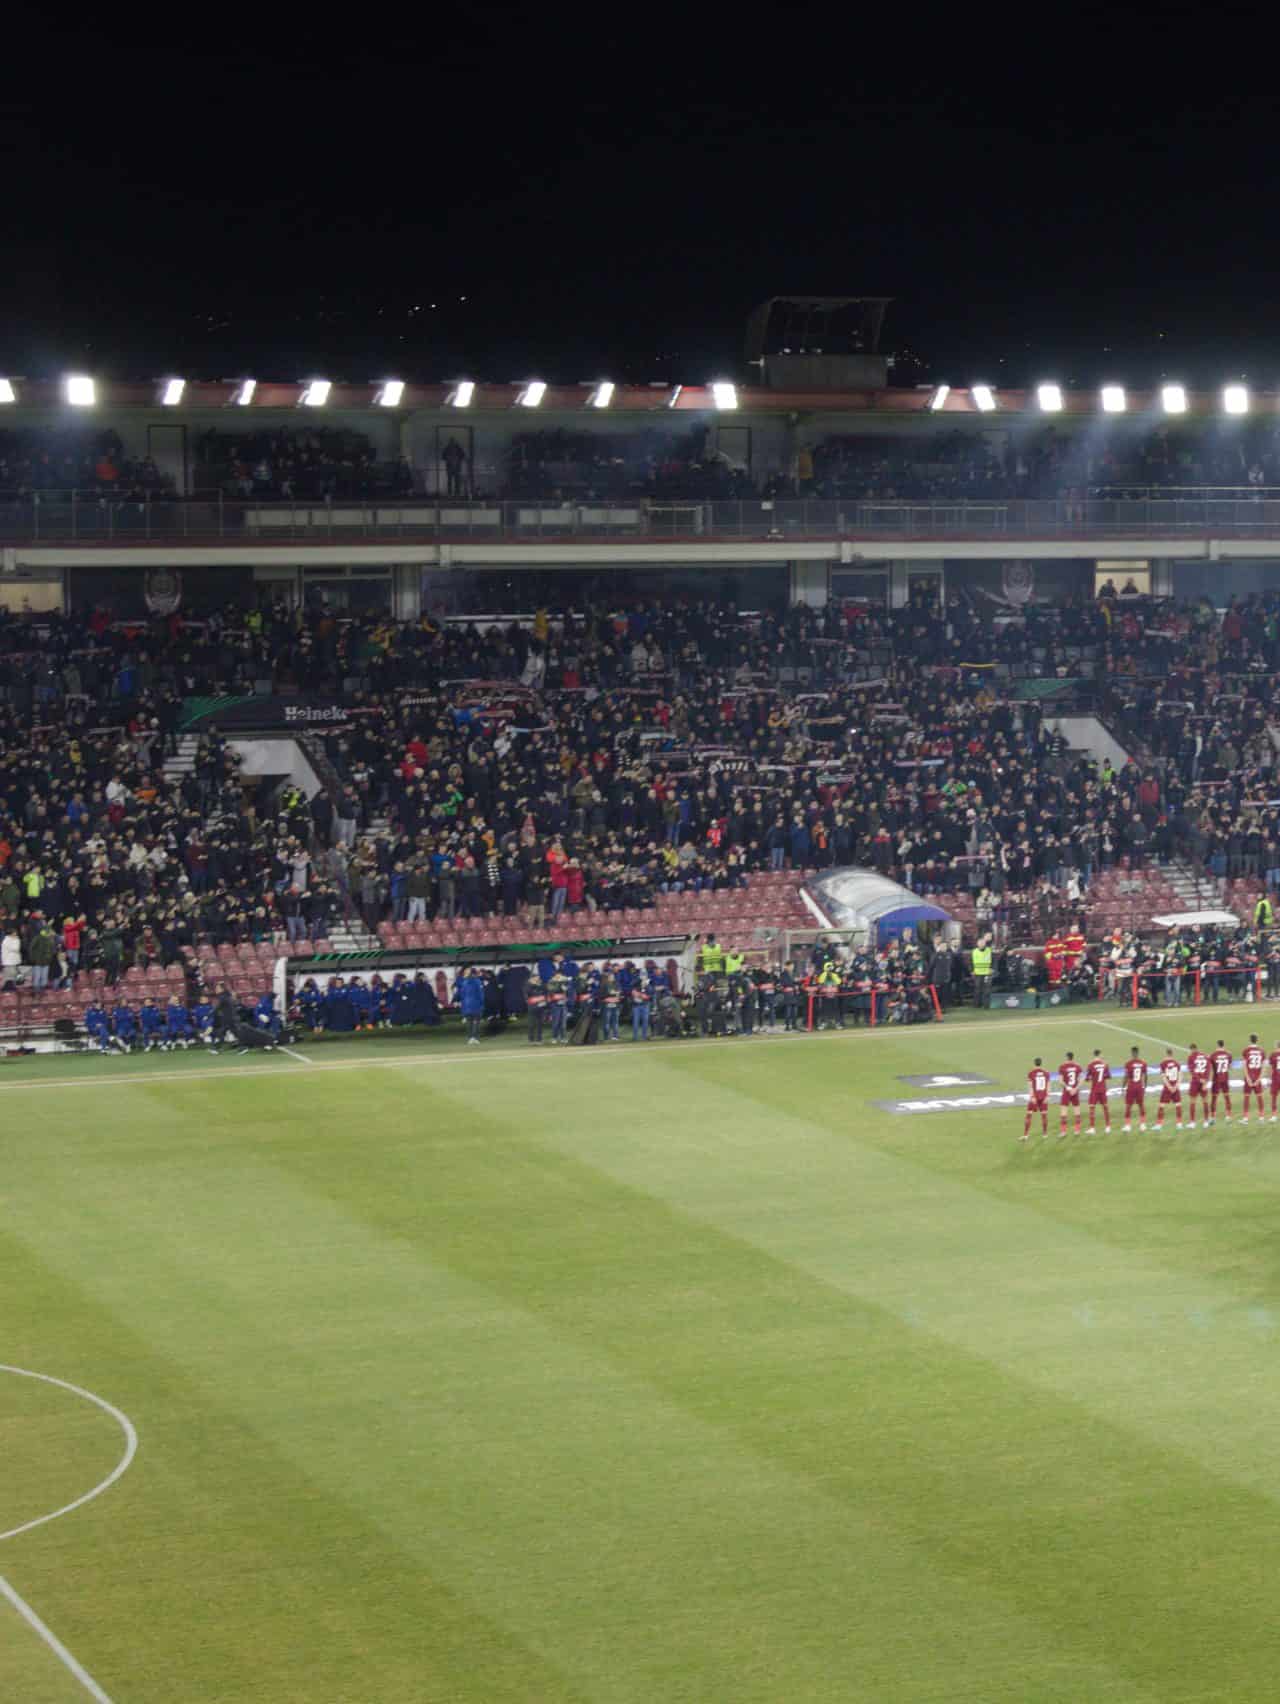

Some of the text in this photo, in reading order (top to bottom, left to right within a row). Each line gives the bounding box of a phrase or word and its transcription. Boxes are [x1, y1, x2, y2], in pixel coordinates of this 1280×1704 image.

[1194, 1059, 1207, 1073] 32
[1216, 1059, 1229, 1073] 73
[1067, 1071, 1076, 1085] 3
[1096, 1068, 1104, 1082] 7
